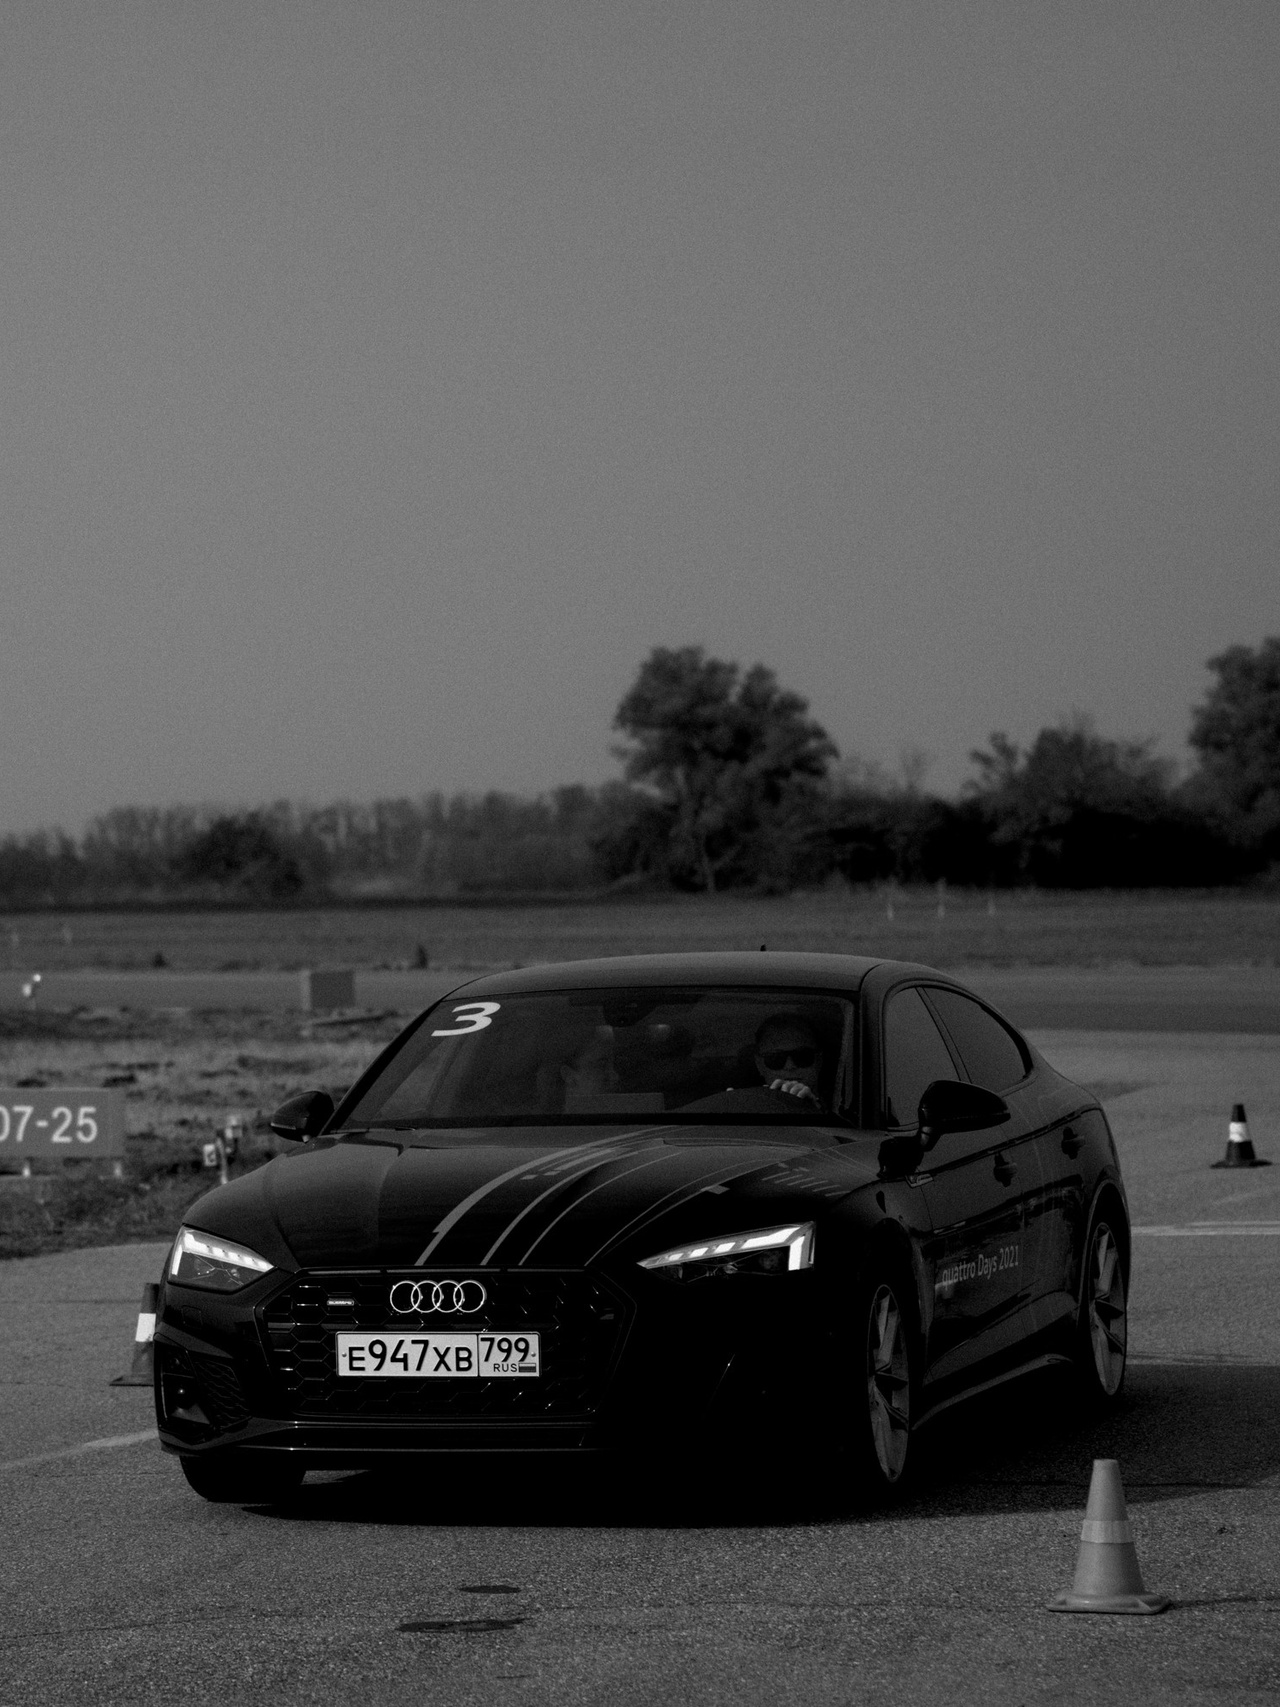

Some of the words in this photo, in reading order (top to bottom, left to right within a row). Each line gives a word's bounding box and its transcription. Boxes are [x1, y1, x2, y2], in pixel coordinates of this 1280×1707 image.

[430, 1001, 501, 1037] 3
[942, 1261, 976, 1291] quattro
[978, 1253, 998, 1280] Days
[998, 1245, 1019, 1271] 2021
[480, 1337, 530, 1362] 799
[493, 1363, 518, 1373] RUS
